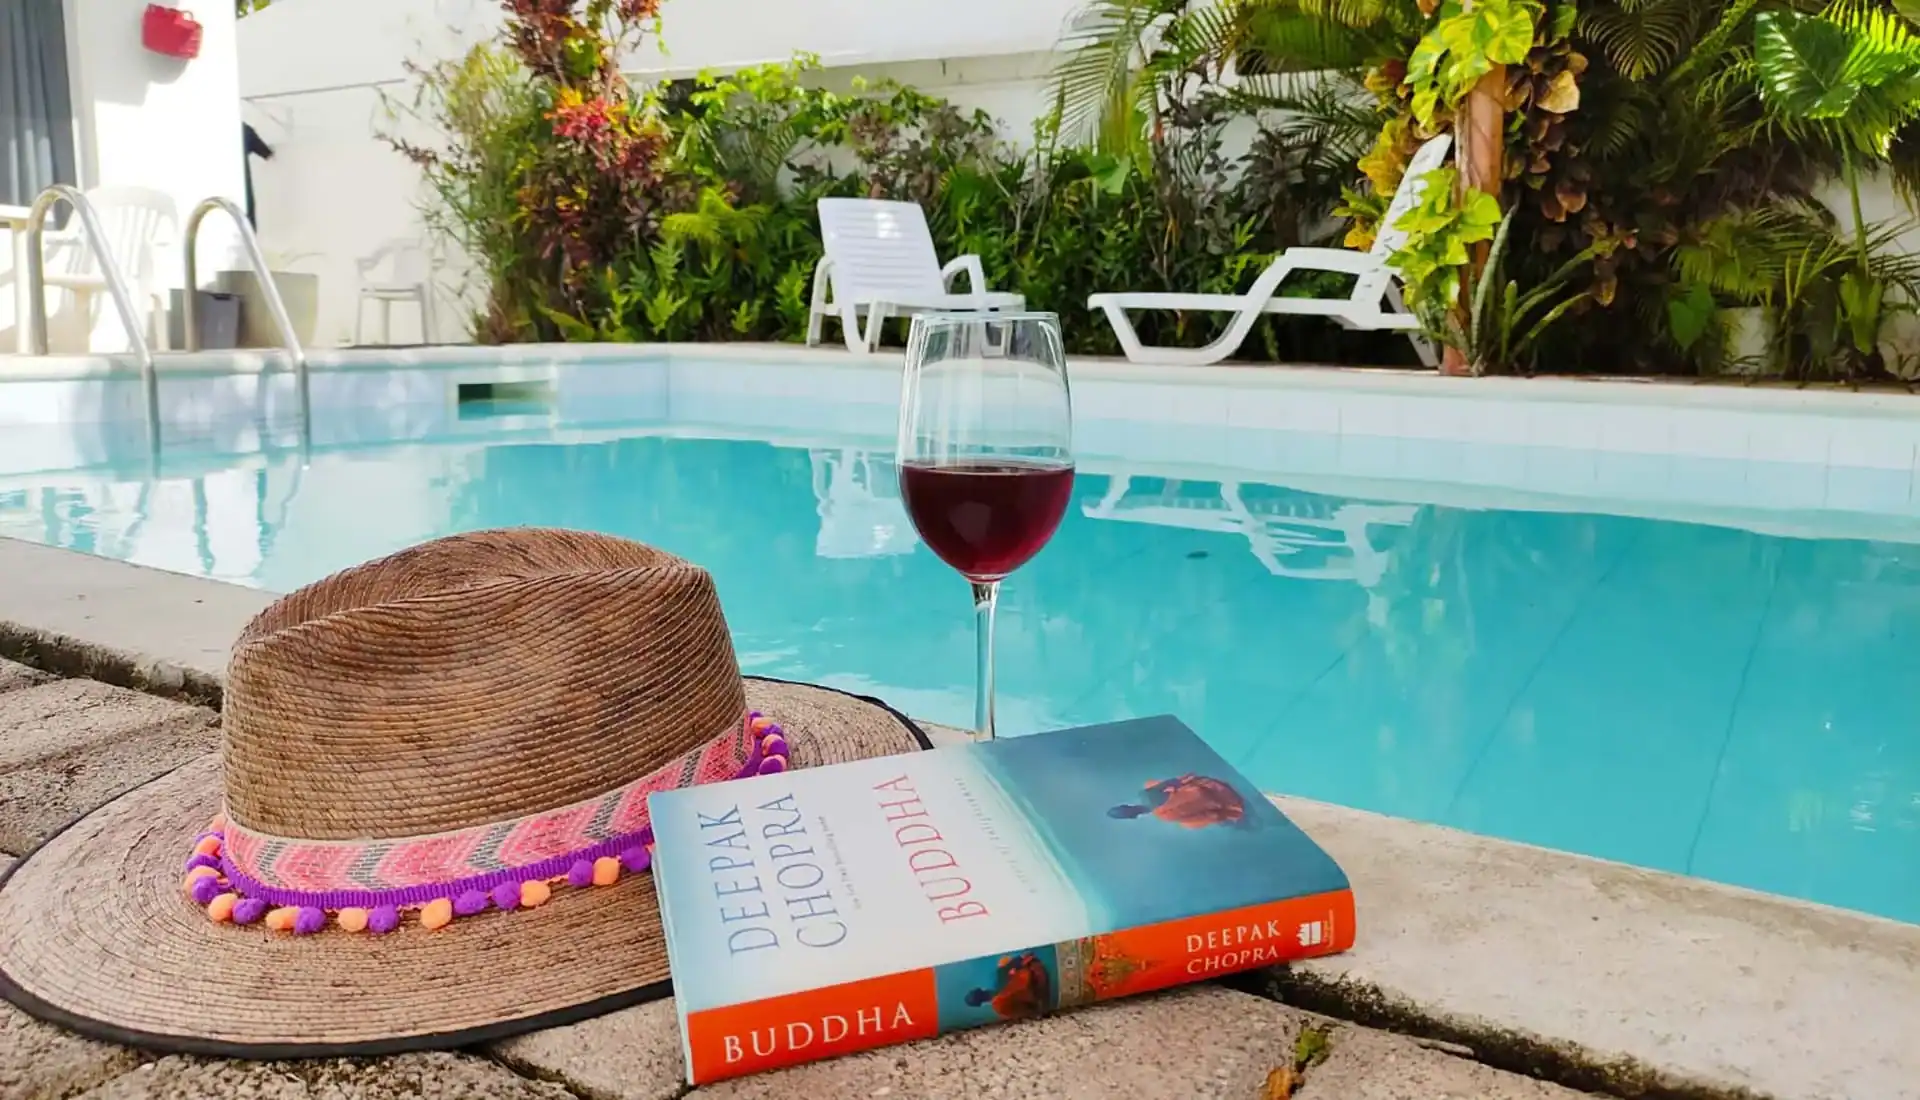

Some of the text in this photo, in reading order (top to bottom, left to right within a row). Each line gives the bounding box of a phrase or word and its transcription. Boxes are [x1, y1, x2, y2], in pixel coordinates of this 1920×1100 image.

[697, 804, 780, 957] DEEPAK
[755, 793, 848, 948] CHOPRA
[872, 773, 990, 925] BUDDHA
[1186, 920, 1281, 953] DEEPAK
[1186, 945, 1279, 975] CHOPRA
[723, 1001, 915, 1064] BUDDHA
